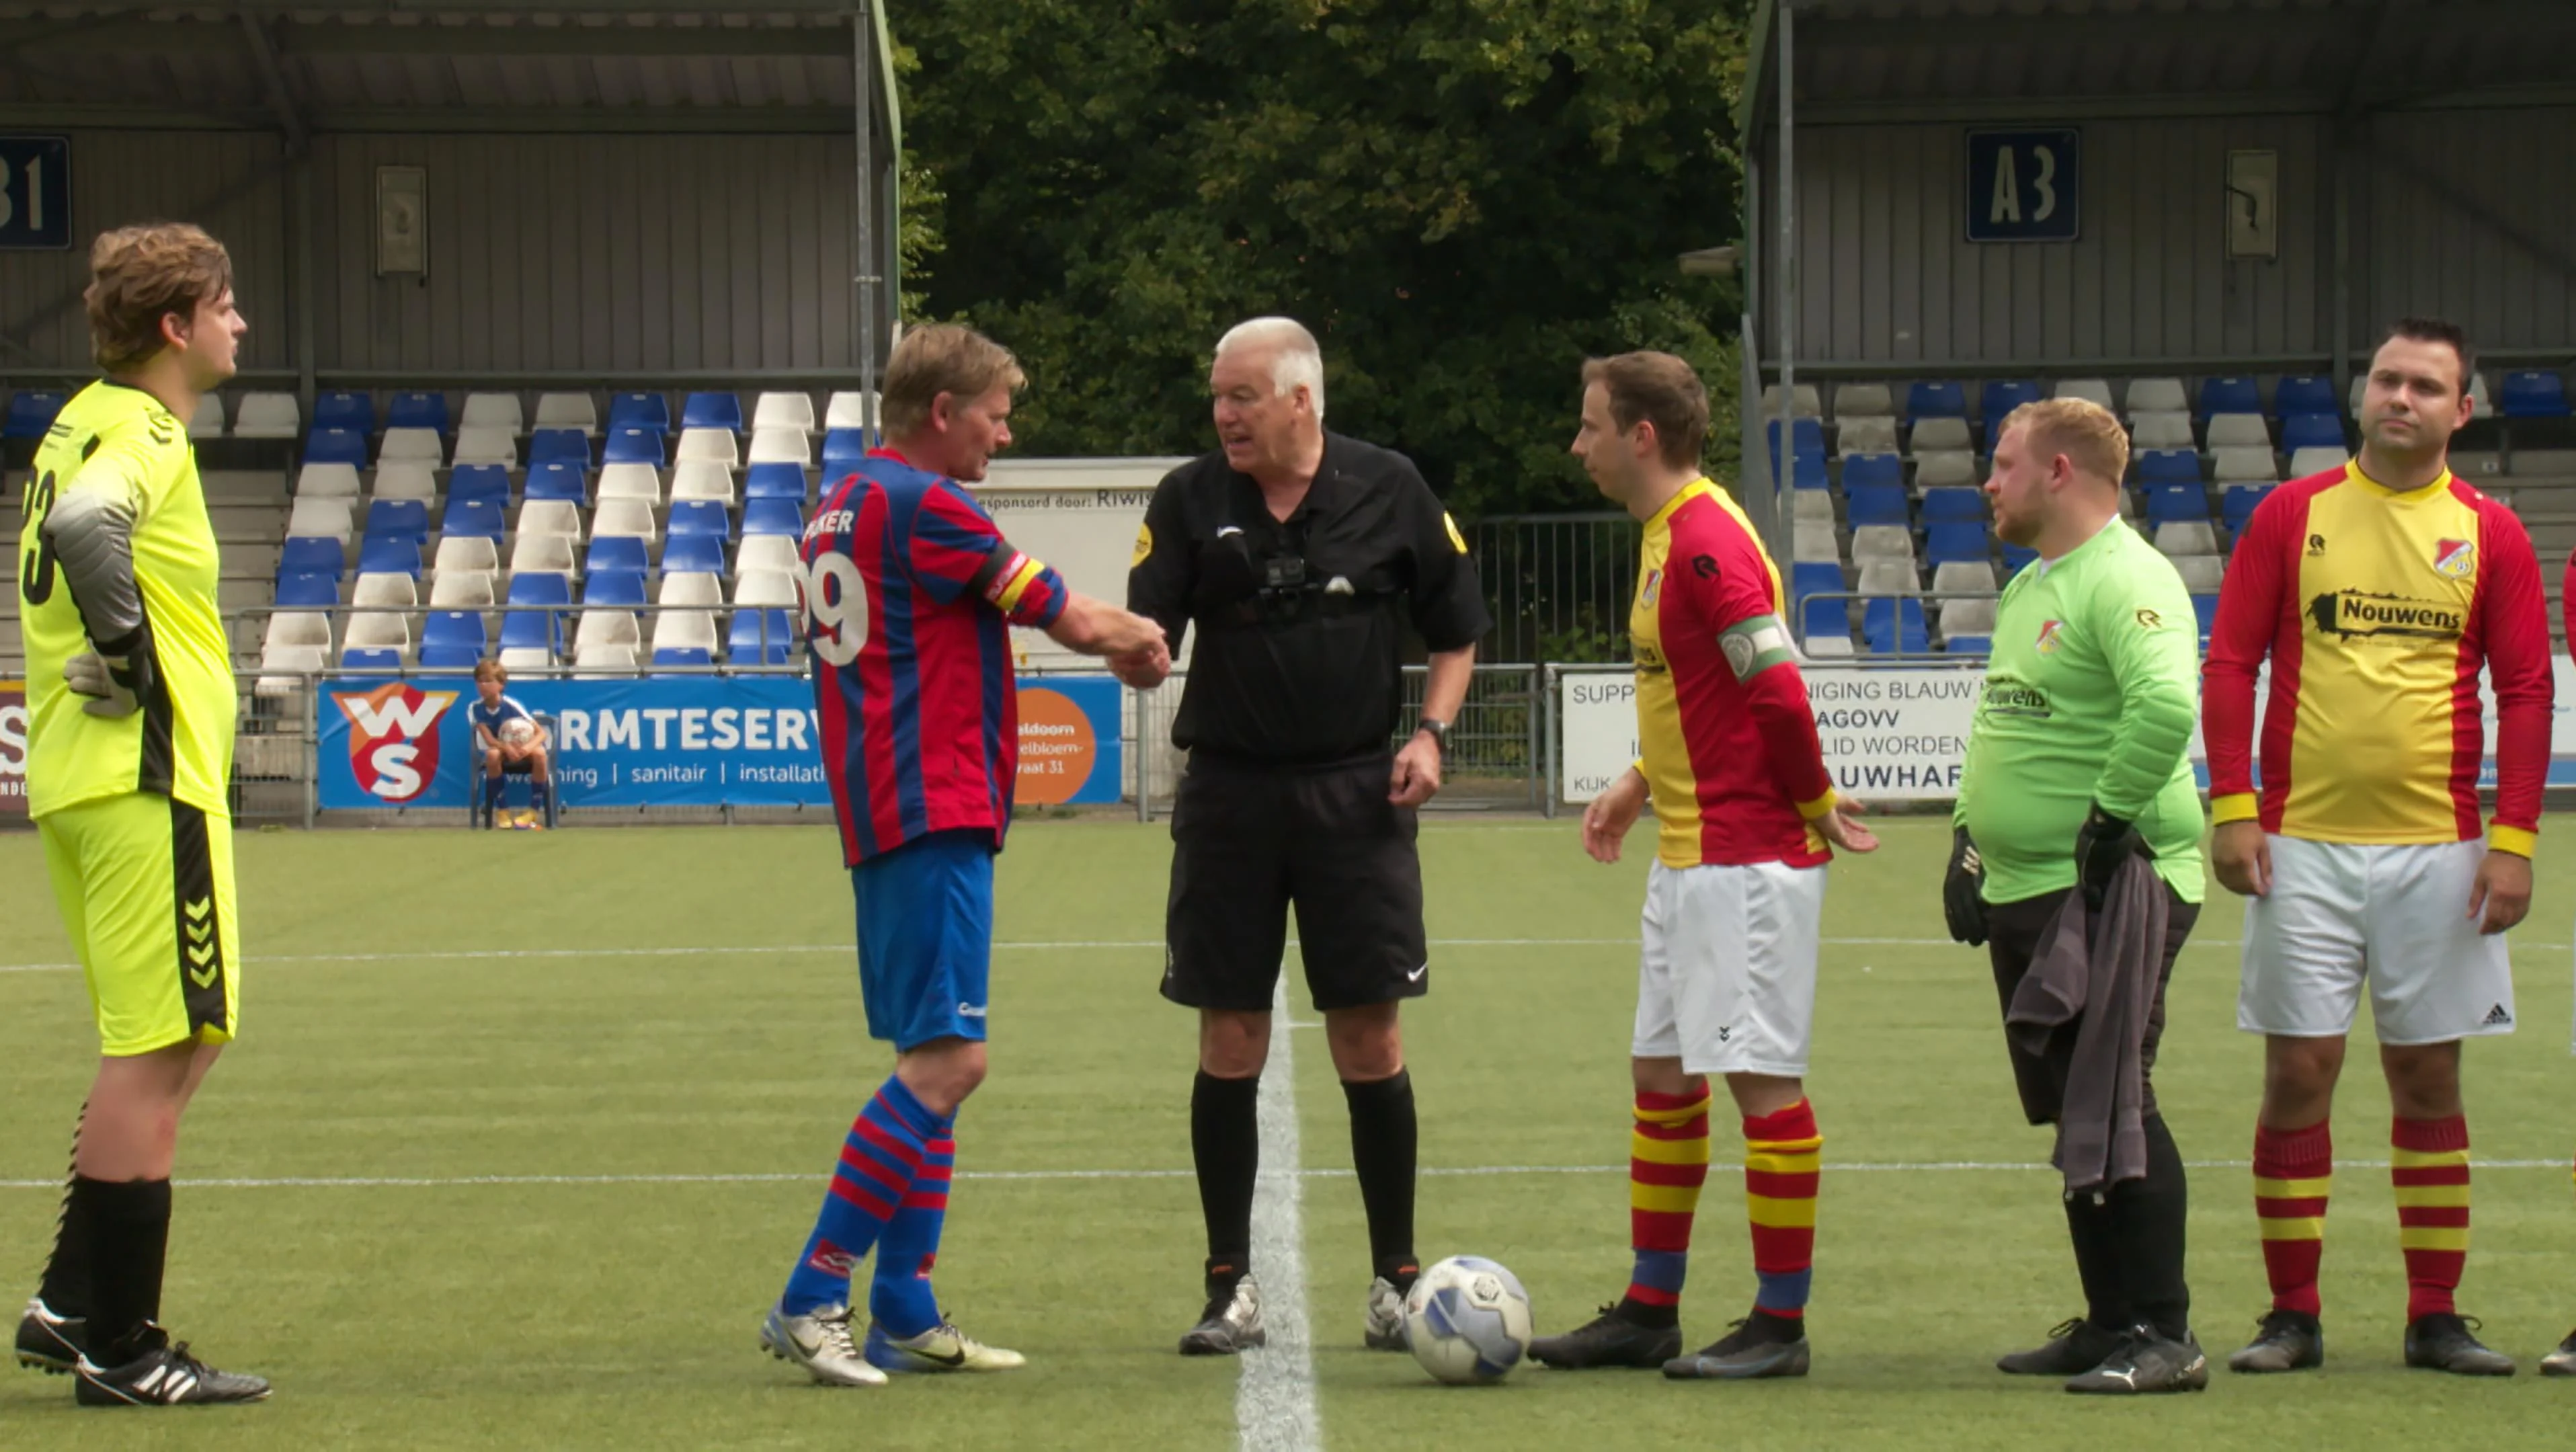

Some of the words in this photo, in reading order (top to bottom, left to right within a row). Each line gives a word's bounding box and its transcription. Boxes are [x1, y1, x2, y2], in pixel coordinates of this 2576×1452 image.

[1990, 145, 2056, 223] A3
[2343, 599, 2460, 629] Nouwens
[1573, 684, 1635, 704] SUPP
[1889, 681, 1972, 700] BLAUW
[1817, 709, 1900, 728] AGOVV
[1863, 736, 1968, 755] WORDEN
[631, 764, 707, 782] sanitair
[1048, 760, 1065, 774] 31
[1574, 776, 1611, 792] KIJK
